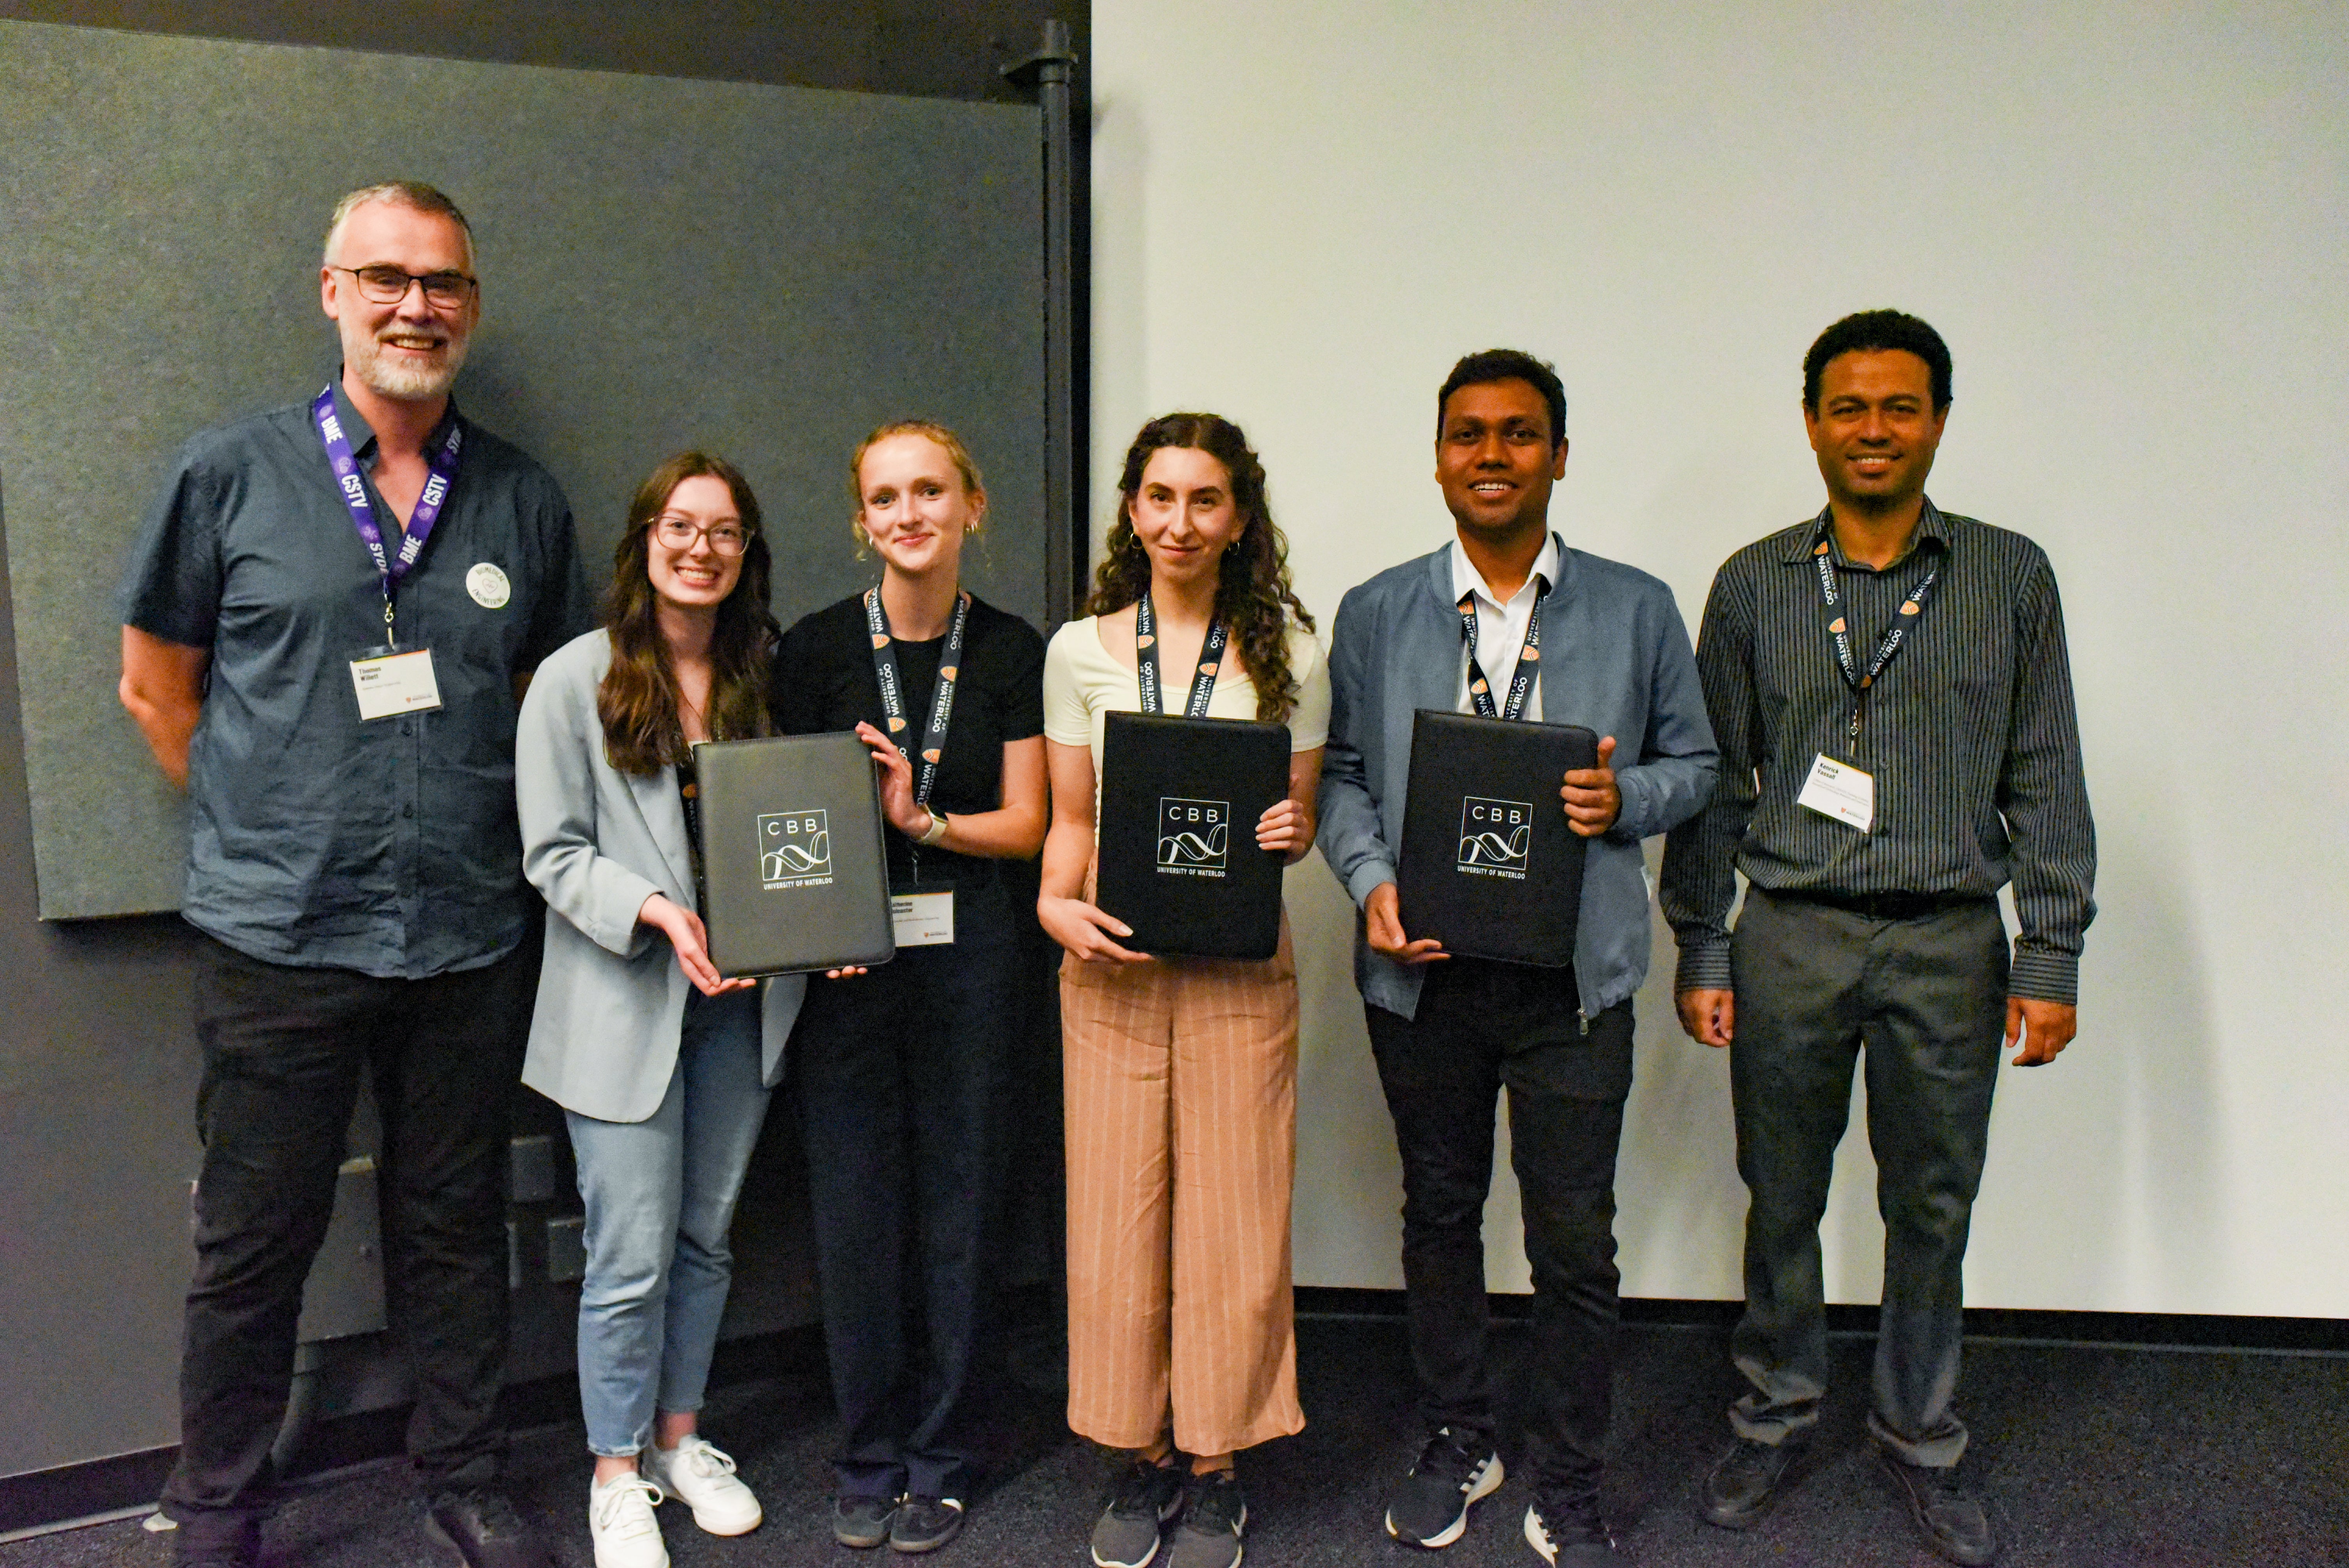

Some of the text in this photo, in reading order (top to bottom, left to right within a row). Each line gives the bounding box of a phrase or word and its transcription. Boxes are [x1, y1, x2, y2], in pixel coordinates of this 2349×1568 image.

[321, 415, 343, 444] BME
[342, 474, 368, 507] CSTV
[422, 474, 447, 506] CSTV
[399, 534, 422, 565] BME
[1818, 555, 1834, 605] WATERLOO
[950, 600, 964, 650] WATERLOO
[1836, 633, 1855, 685] WATERLOO
[1871, 629, 1902, 675] WATERLOO
[358, 666, 381, 675] Thomas
[360, 674, 379, 682] Willett
[881, 679, 891, 714] UNIVERSITY
[883, 663, 900, 716] WATERLOO
[943, 685, 953, 721] UNIVERSITY
[1144, 662, 1156, 713] WATERLOO
[1200, 680, 1212, 714] UNIVERSITY
[932, 681, 950, 732] WATERLOO
[1817, 768, 1836, 780] Vassall
[1819, 762, 1839, 774] Kenrick
[768, 818, 817, 835] CBB
[1169, 806, 1218, 823] CBB
[1472, 806, 1521, 823] CBB
[763, 881, 795, 890] UNIVERSITY
[804, 877, 833, 886] WATERLOO
[1157, 866, 1187, 875] UNIVERSITY
[1197, 869, 1226, 878] WATERLOO
[1458, 865, 1488, 875] UNIVERSITY
[1497, 870, 1526, 880] WATERLOO
